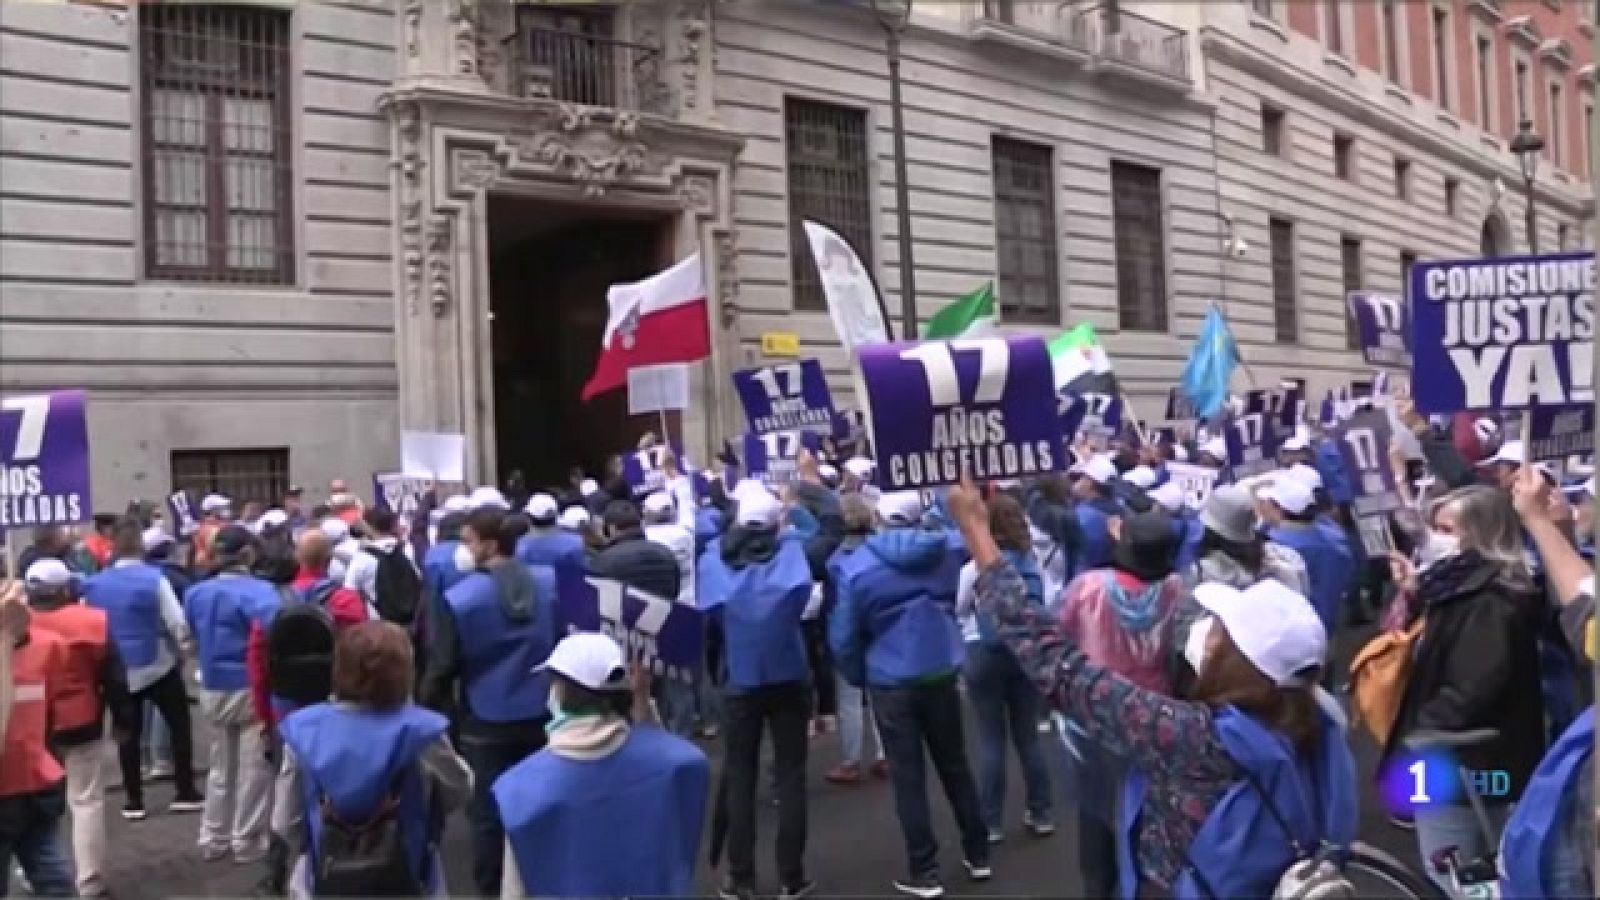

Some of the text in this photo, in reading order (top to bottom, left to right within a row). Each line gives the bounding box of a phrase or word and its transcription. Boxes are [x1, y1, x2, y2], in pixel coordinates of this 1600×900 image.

[1365, 297, 1400, 328] 17
[1441, 293, 1595, 345] JUSTAS
[752, 364, 802, 397] 17
[901, 340, 1008, 406] 17
[1447, 342, 1596, 408] YA!
[1080, 393, 1112, 415] 17
[760, 433, 799, 457] 17
[931, 407, 1006, 449] AÑOS
[1235, 415, 1262, 446] 17
[1344, 428, 1379, 469] 17
[889, 440, 1054, 487] CONGELADAS
[584, 576, 672, 635] 17
